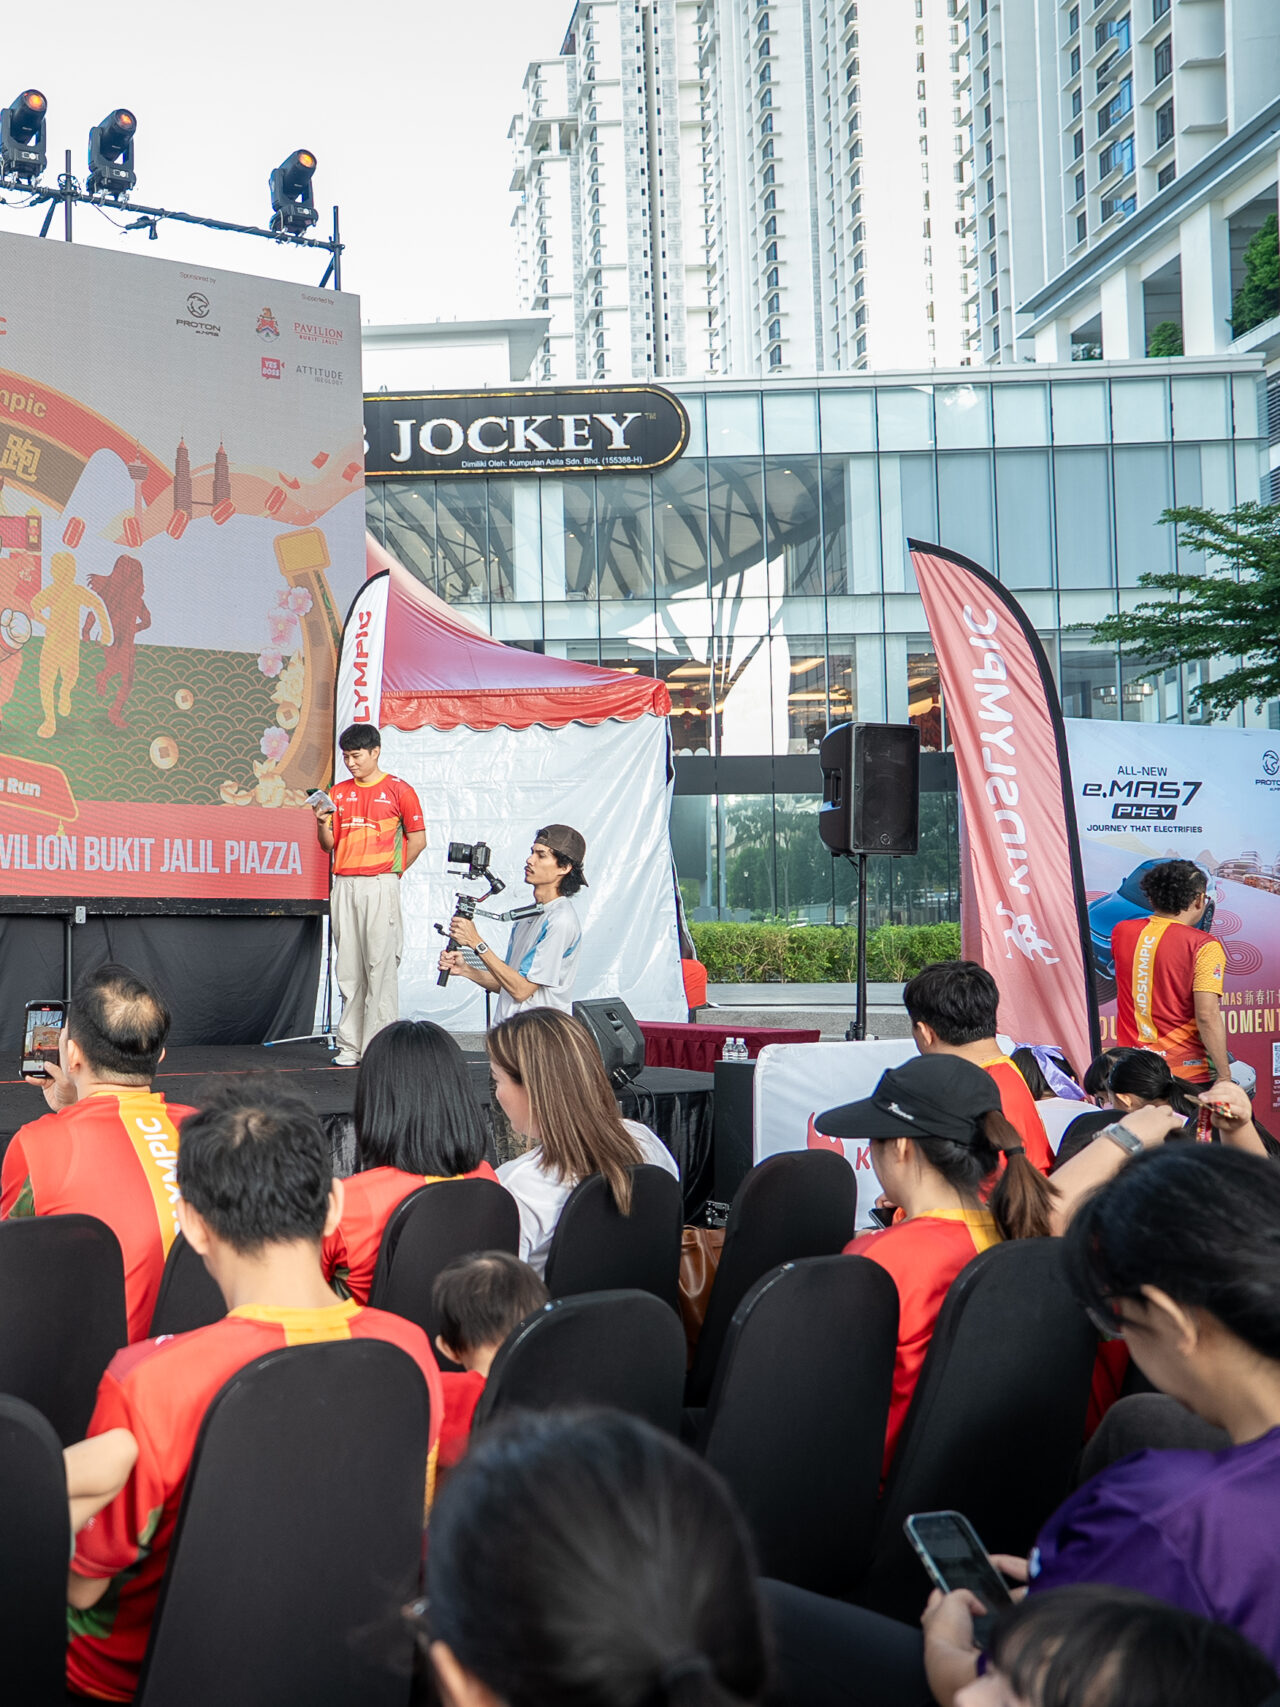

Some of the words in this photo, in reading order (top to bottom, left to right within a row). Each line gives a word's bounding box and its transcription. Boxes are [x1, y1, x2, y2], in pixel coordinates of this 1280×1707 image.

[176, 319, 221, 332] PROTON
[294, 322, 343, 339] PAVILION
[296, 365, 343, 380] ATTITUDE
[390, 412, 642, 463] JOCKEY
[461, 459, 486, 468] Dimiliki
[488, 459, 508, 468] Oleh:
[509, 458, 545, 468] Kumpulan
[546, 458, 564, 466] Asita
[565, 457, 582, 466] Sdn.
[584, 457, 600, 465] Bhd.
[1117, 766, 1167, 776] ALL-NEW
[7, 781, 41, 797] Run
[1117, 806, 1173, 817] PHEV
[1130, 825, 1151, 833] THAT
[1154, 825, 1203, 833] ELECTRIFIES
[84, 836, 154, 872] BUKIT
[160, 838, 219, 873] JALIL
[225, 840, 302, 875] PIAZZA
